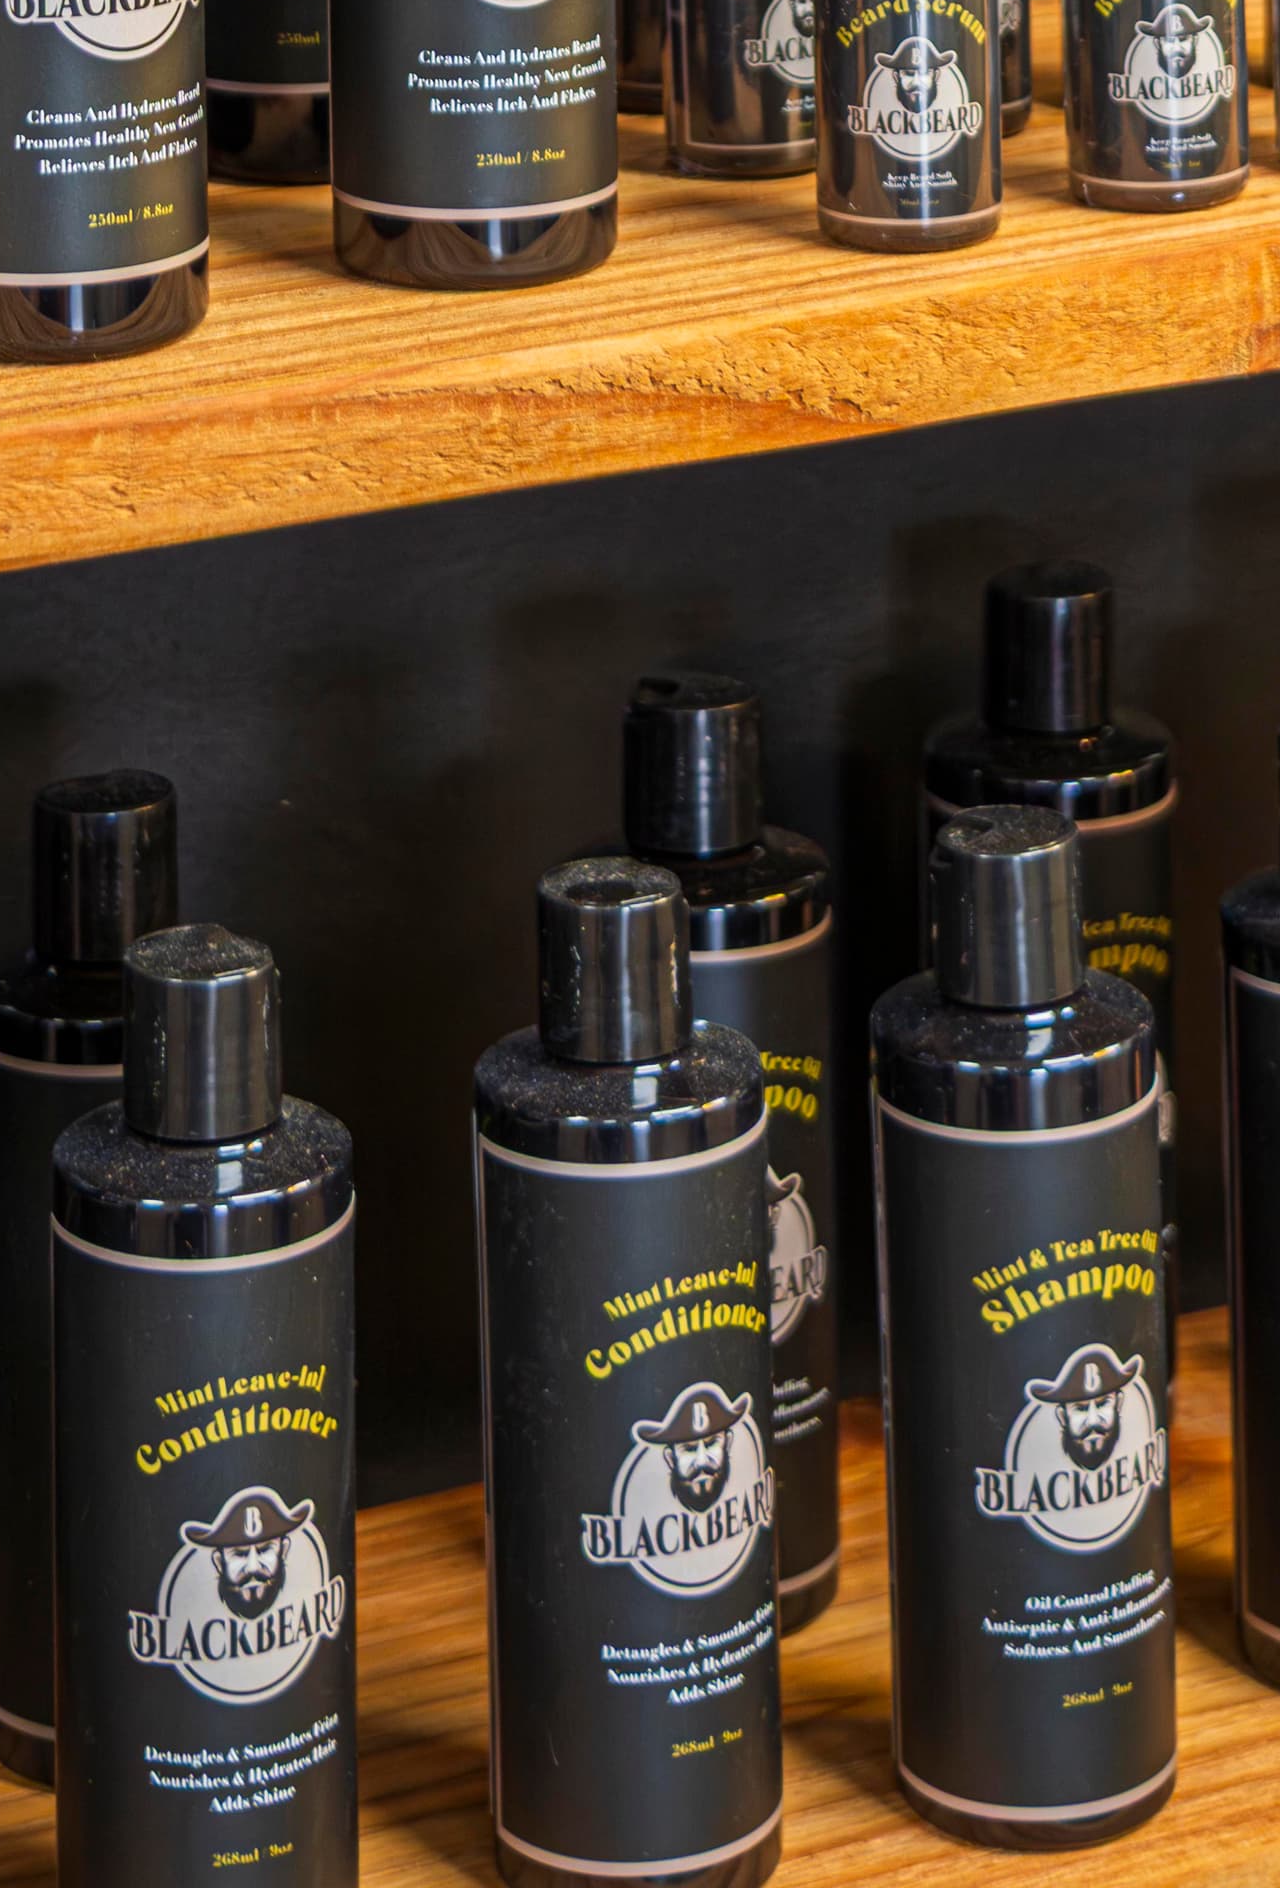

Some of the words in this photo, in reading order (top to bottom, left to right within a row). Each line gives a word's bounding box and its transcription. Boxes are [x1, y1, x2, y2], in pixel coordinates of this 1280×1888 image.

[418, 49, 470, 65] Cleans
[474, 49, 506, 65] And
[510, 46, 570, 67] Hydrates
[572, 34, 601, 55] Beard
[408, 73, 480, 89] Promotes
[483, 71, 541, 89] Healthy
[430, 97, 494, 113] Relieves
[497, 95, 528, 113] Itch
[530, 90, 559, 109] And
[560, 86, 596, 106] Flakes
[26, 109, 81, 125] Cleans
[15, 134, 91, 150] Promotes
[39, 158, 105, 175] Relieves
[476, 151, 521, 167] 250ml
[89, 209, 133, 228] 250ml
[972, 1256, 1028, 1295] Mint
[1029, 1248, 1048, 1269] &
[1049, 1239, 1095, 1262] Tea
[1099, 1229, 1140, 1251] Tree
[602, 1282, 662, 1321] Mint
[981, 1263, 1156, 1334] Shampoo
[585, 1299, 766, 1379] Conditioner
[154, 1380, 215, 1419] Mint
[135, 1401, 338, 1476] Conditioner
[977, 1430, 1166, 1515] BLACKBEARD
[583, 1470, 774, 1563] BLACKBEARD
[1054, 1586, 1109, 1609] Control
[131, 1575, 345, 1662] BLACKBEARD
[601, 1642, 681, 1662] Detangles
[608, 1666, 686, 1684] Nourishes
[144, 1745, 224, 1769] Detangles
[150, 1769, 230, 1791] Nourishes
[209, 1795, 251, 1814] Adds
[252, 1785, 297, 1808] Shine
